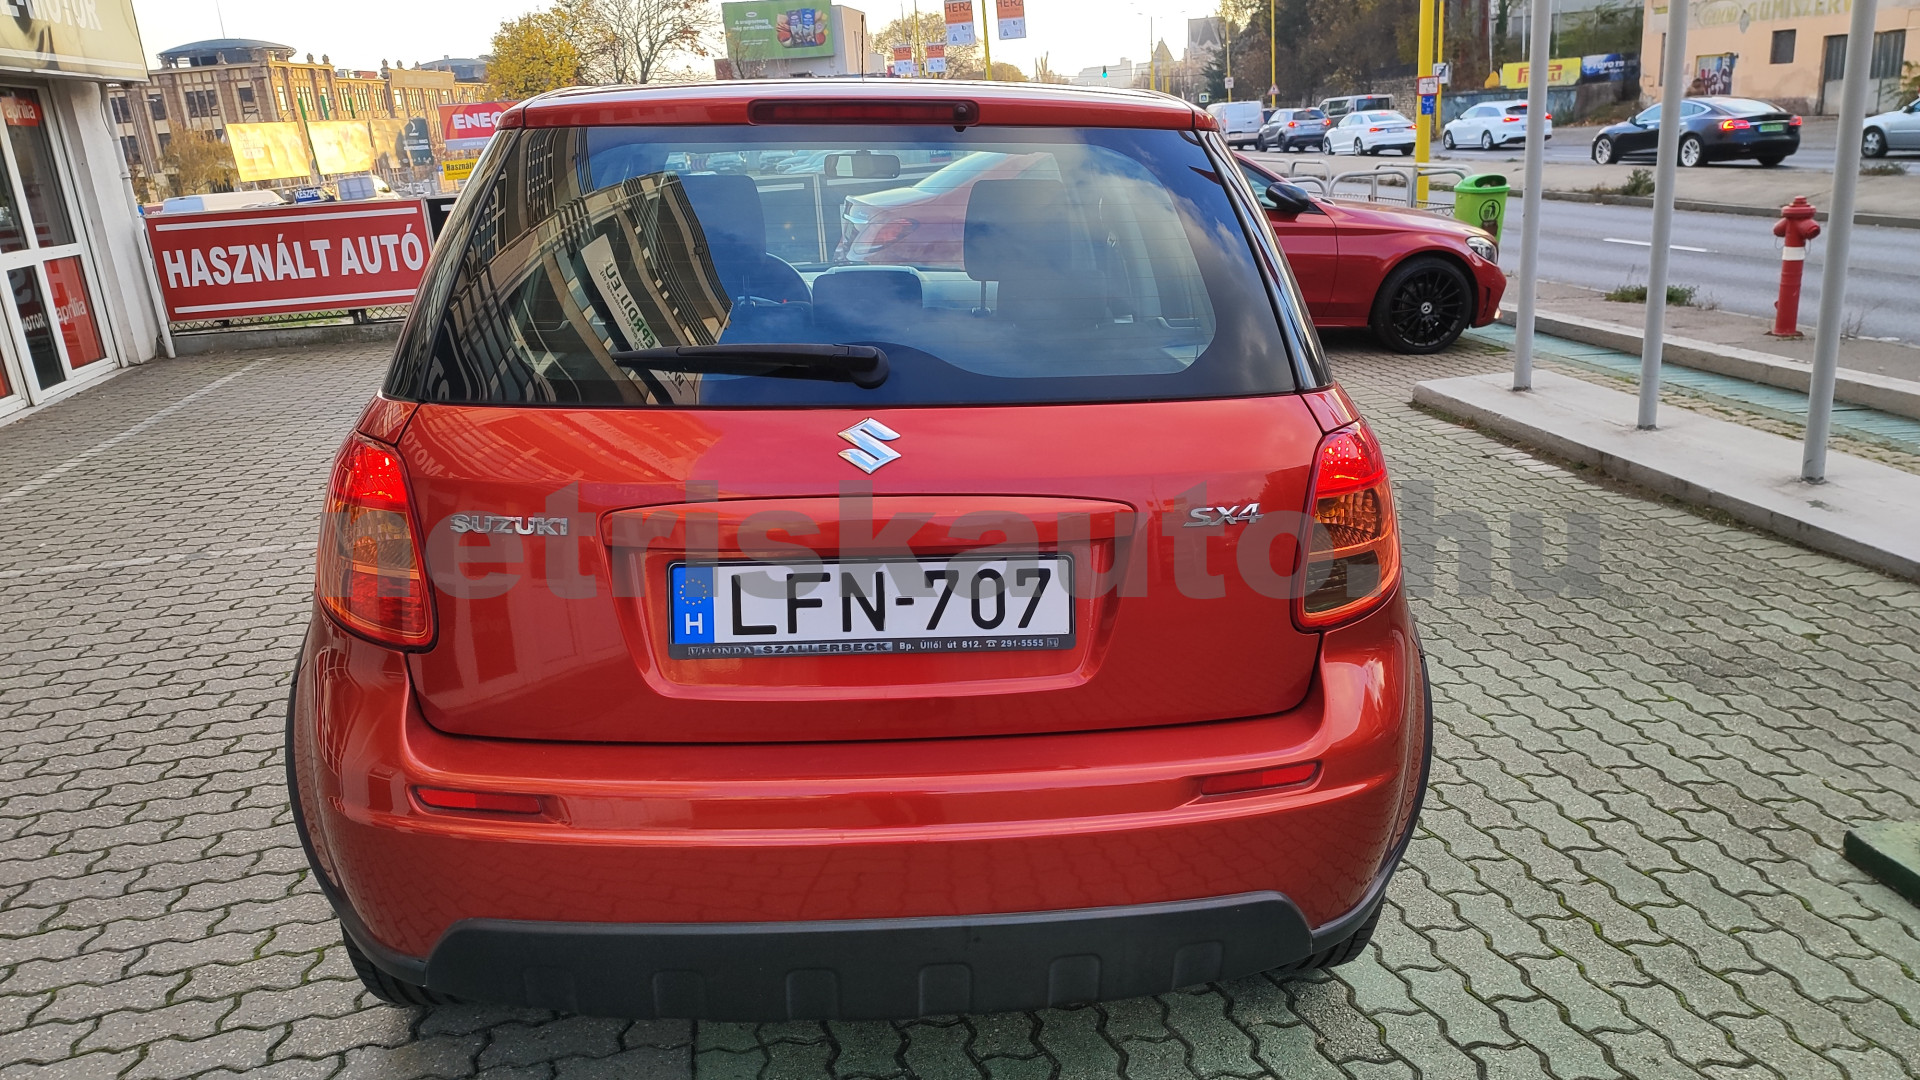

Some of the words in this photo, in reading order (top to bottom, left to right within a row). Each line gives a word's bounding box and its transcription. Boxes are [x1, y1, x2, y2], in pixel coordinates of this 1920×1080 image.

[6, 102, 36, 124] aprilia
[162, 233, 331, 289] HASZNÁLT
[341, 223, 424, 276] AUTÓ
[56, 296, 86, 325] aprilia
[450, 514, 568, 535] SUZUKI
[1183, 502, 1264, 527] SX4
[731, 568, 1051, 636] LFN-707
[685, 613, 703, 635] H
[762, 642, 888, 655] SZALLERBECK
[899, 641, 915, 651] Bp.
[947, 640, 957, 649] út
[962, 640, 982, 649] 812.
